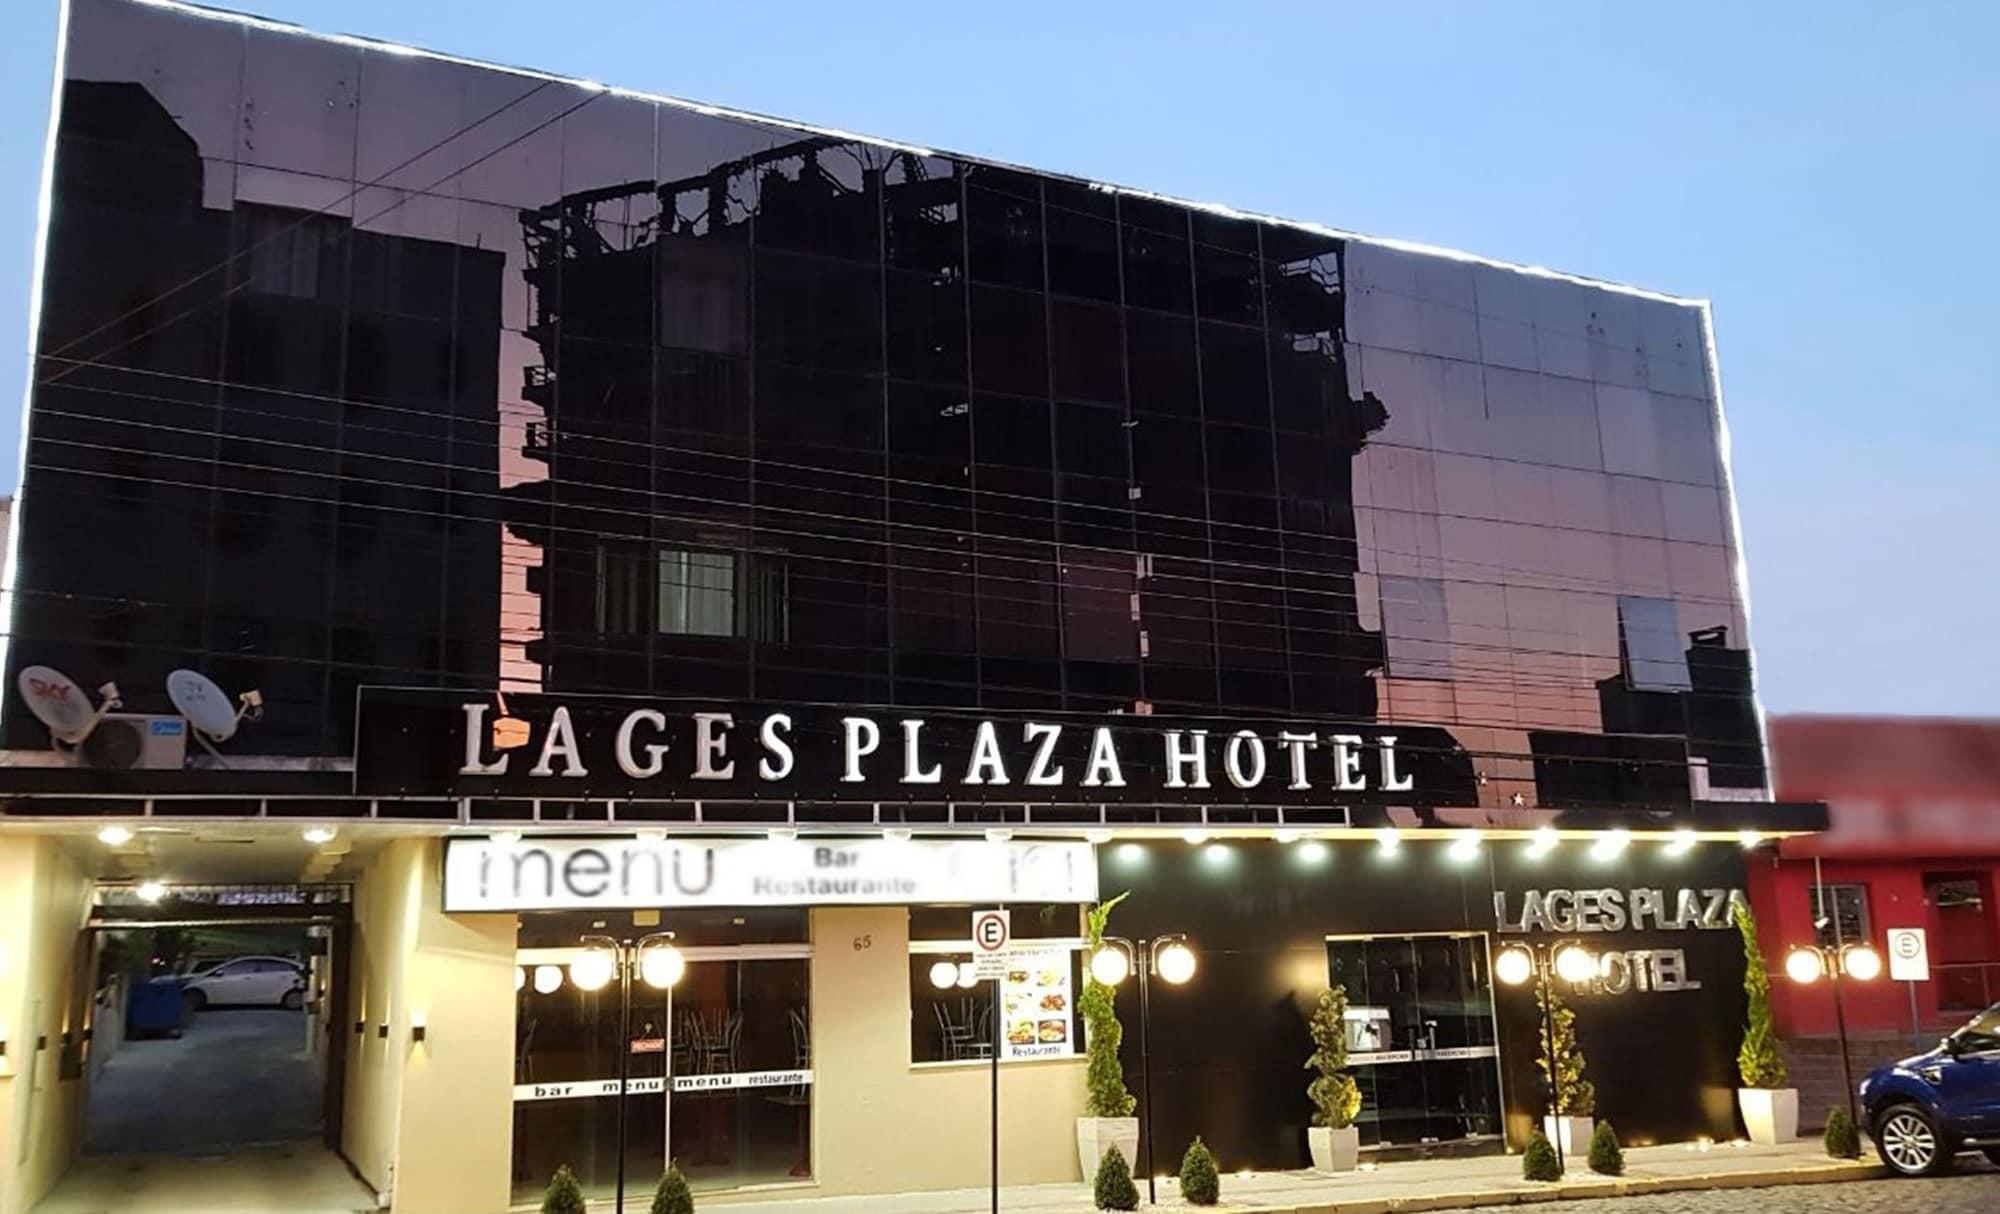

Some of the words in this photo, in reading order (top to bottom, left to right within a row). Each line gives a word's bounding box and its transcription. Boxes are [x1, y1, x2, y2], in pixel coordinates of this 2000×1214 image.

[458, 703, 795, 780] LAGES
[839, 717, 1127, 788] PLAZA
[1163, 729, 1414, 791] HOTEL
[814, 847, 860, 868] Bar
[479, 847, 714, 898] menu
[753, 875, 917, 896] Restaurante
[1494, 888, 1626, 933] LAGES
[1629, 888, 1750, 932] PLAZA
[853, 934, 873, 951] 65
[985, 922, 998, 943] E
[535, 1084, 574, 1098] bar
[602, 1079, 659, 1092] menu
[677, 1075, 732, 1088] menu
[749, 1072, 804, 1085] restaurante
